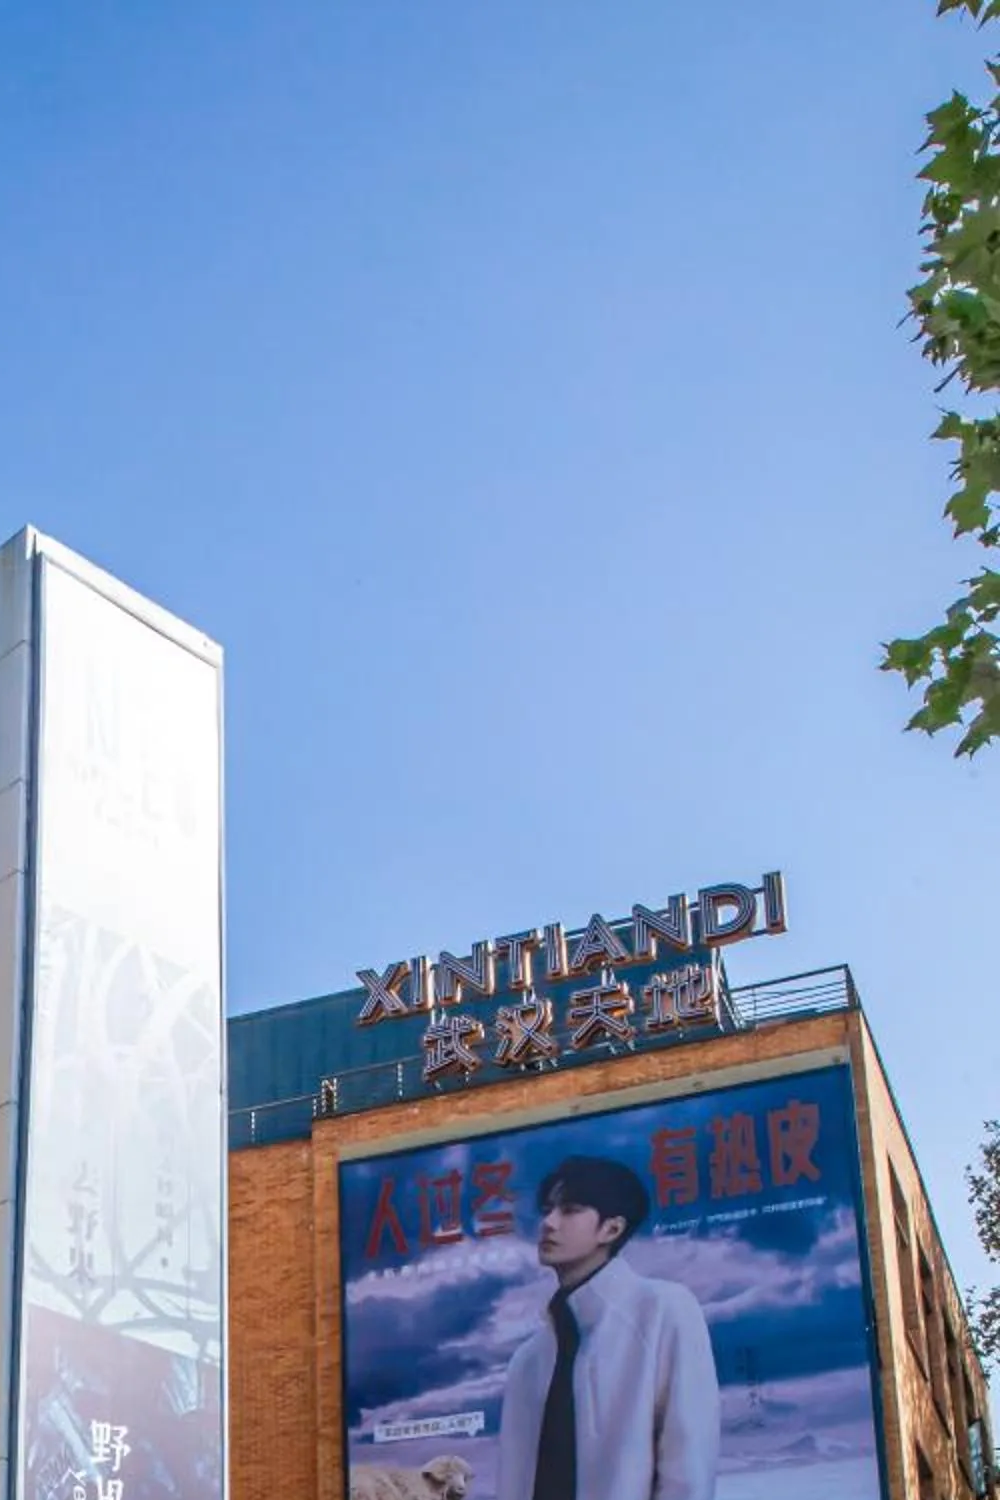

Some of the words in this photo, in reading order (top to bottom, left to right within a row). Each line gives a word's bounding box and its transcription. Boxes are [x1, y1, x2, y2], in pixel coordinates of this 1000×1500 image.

[355, 870, 788, 1026] XINTIANDI
[422, 963, 718, 1083] 武汉天地
[365, 1159, 516, 1258] 人过冬
